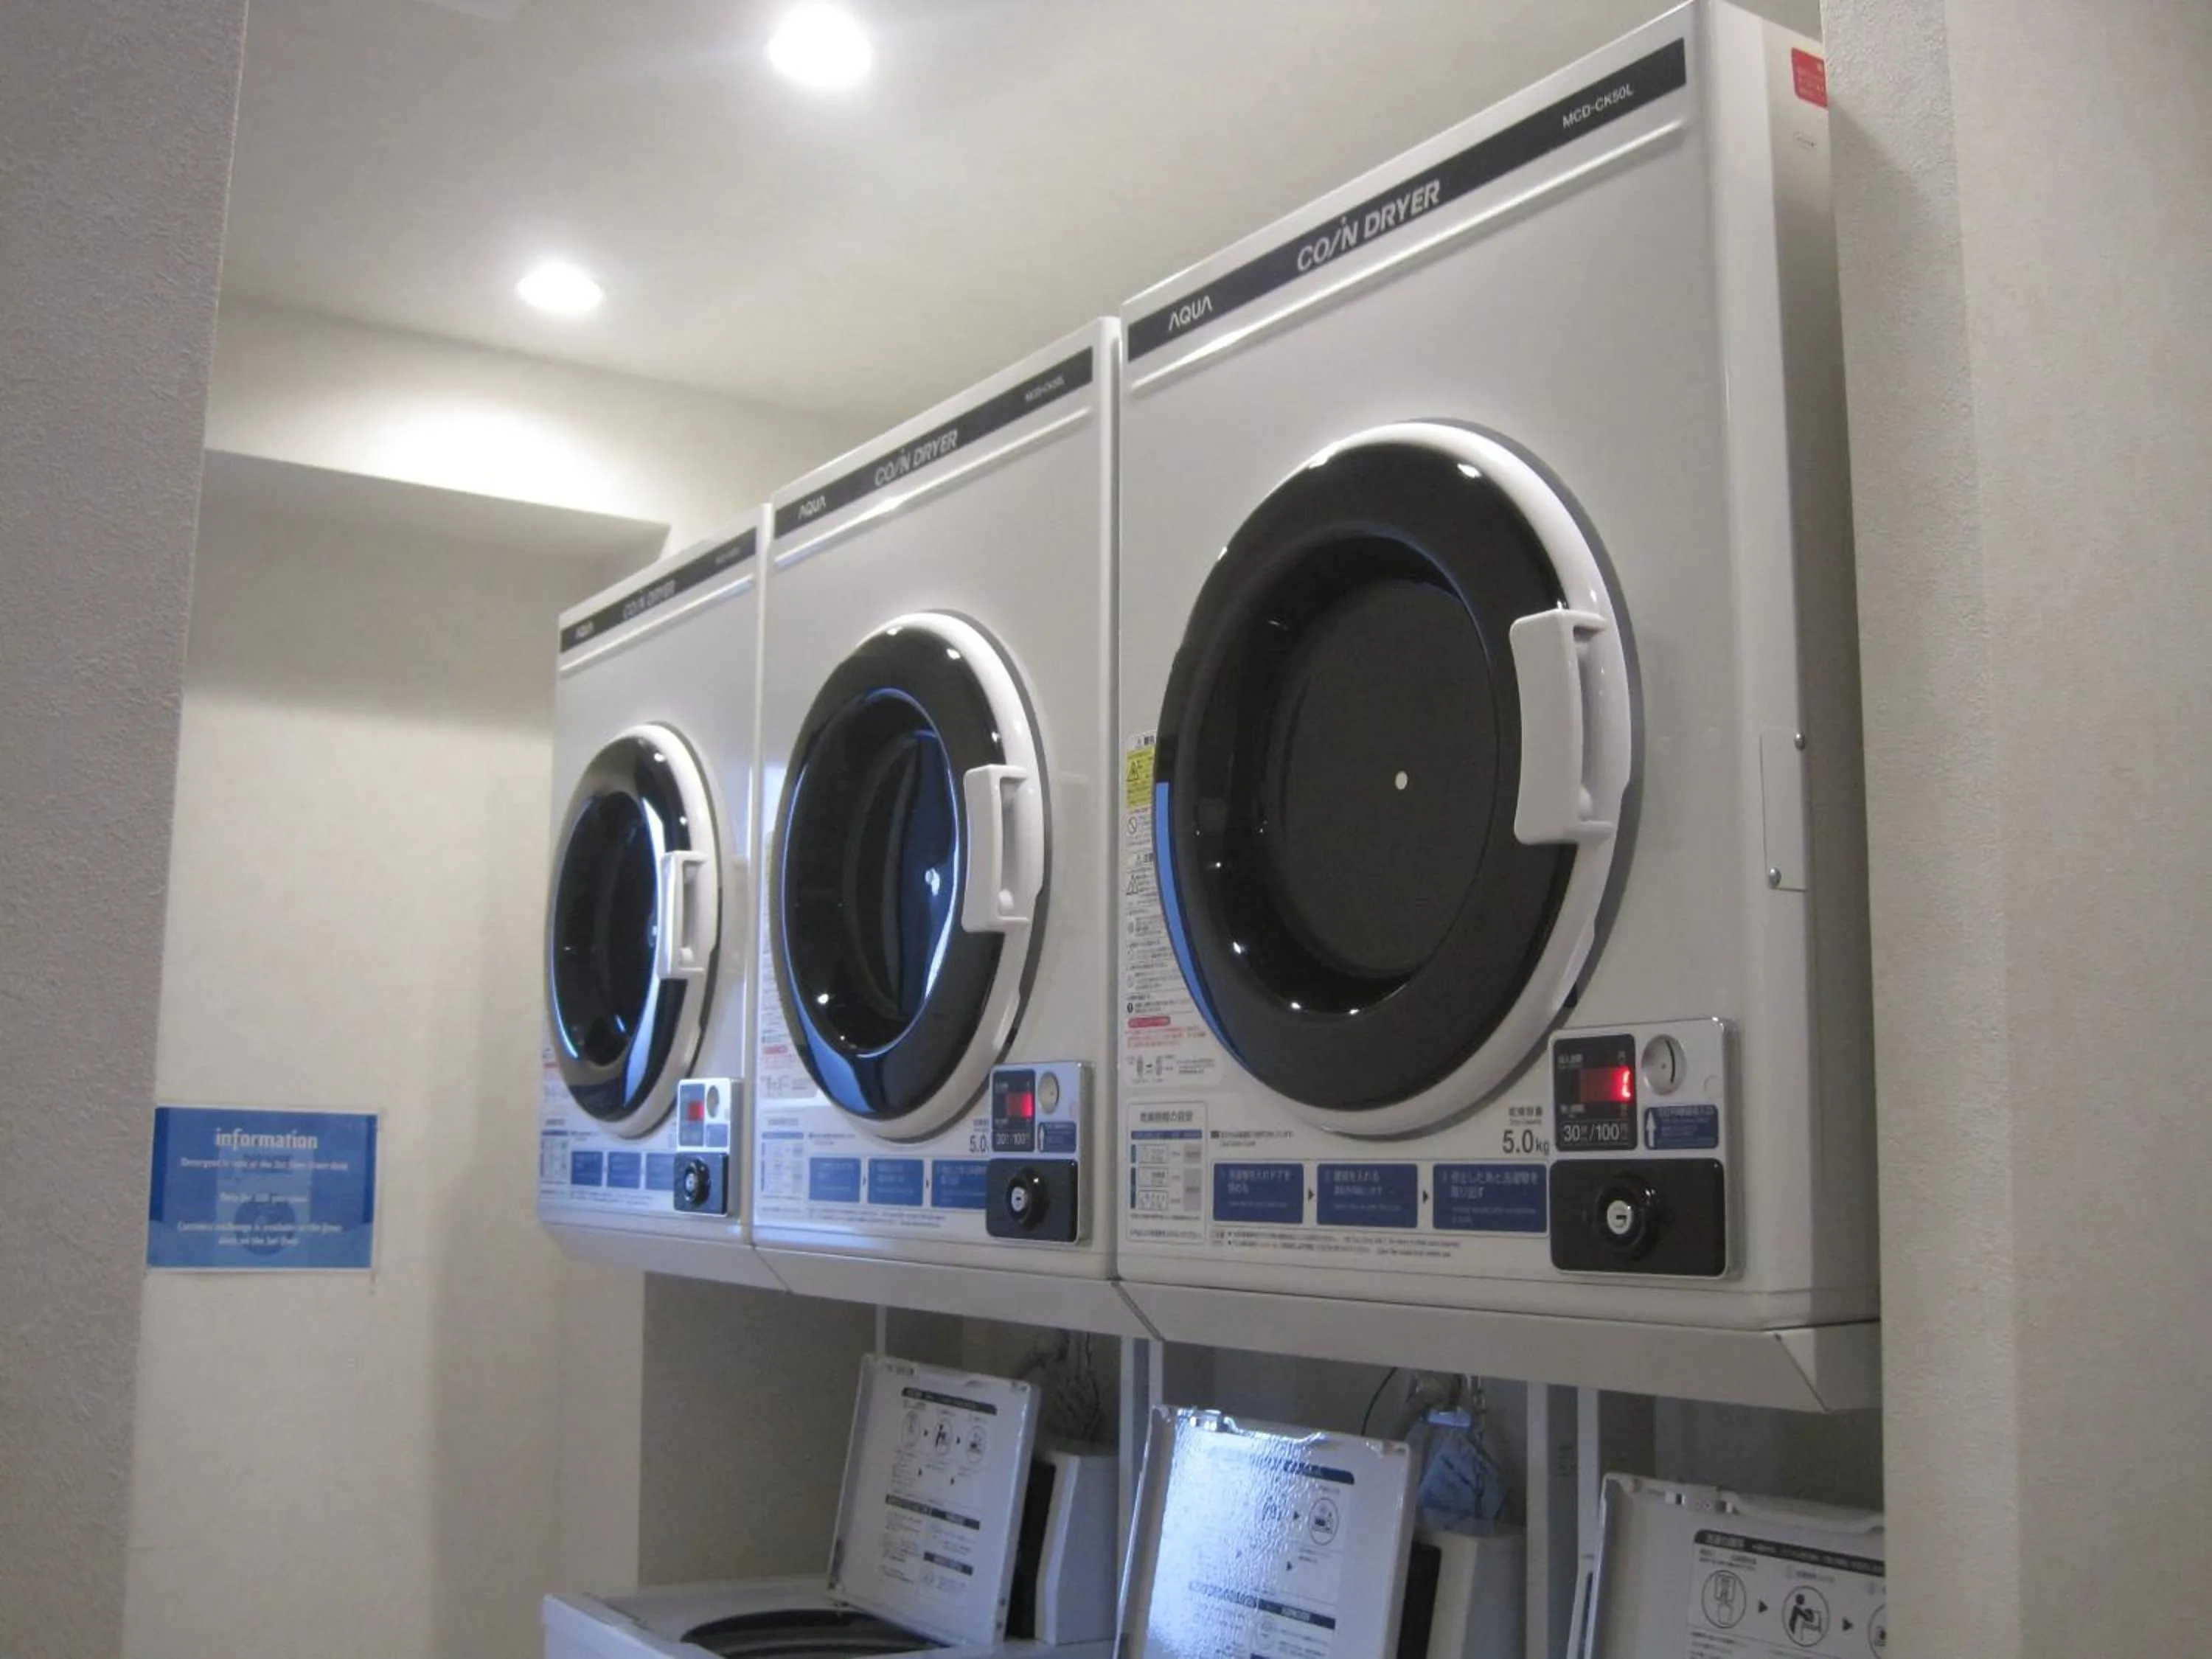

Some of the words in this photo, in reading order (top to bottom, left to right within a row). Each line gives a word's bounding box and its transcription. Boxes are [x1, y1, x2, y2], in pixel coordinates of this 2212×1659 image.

[1562, 83, 1635, 129] MCD-CK50L
[1297, 215, 1359, 272] COIN
[1363, 178, 1440, 240] DRYER
[1168, 295, 1213, 331] AQUA
[912, 428, 958, 468] DRYER
[798, 495, 827, 519] AQUA
[215, 1127, 319, 1150] information
